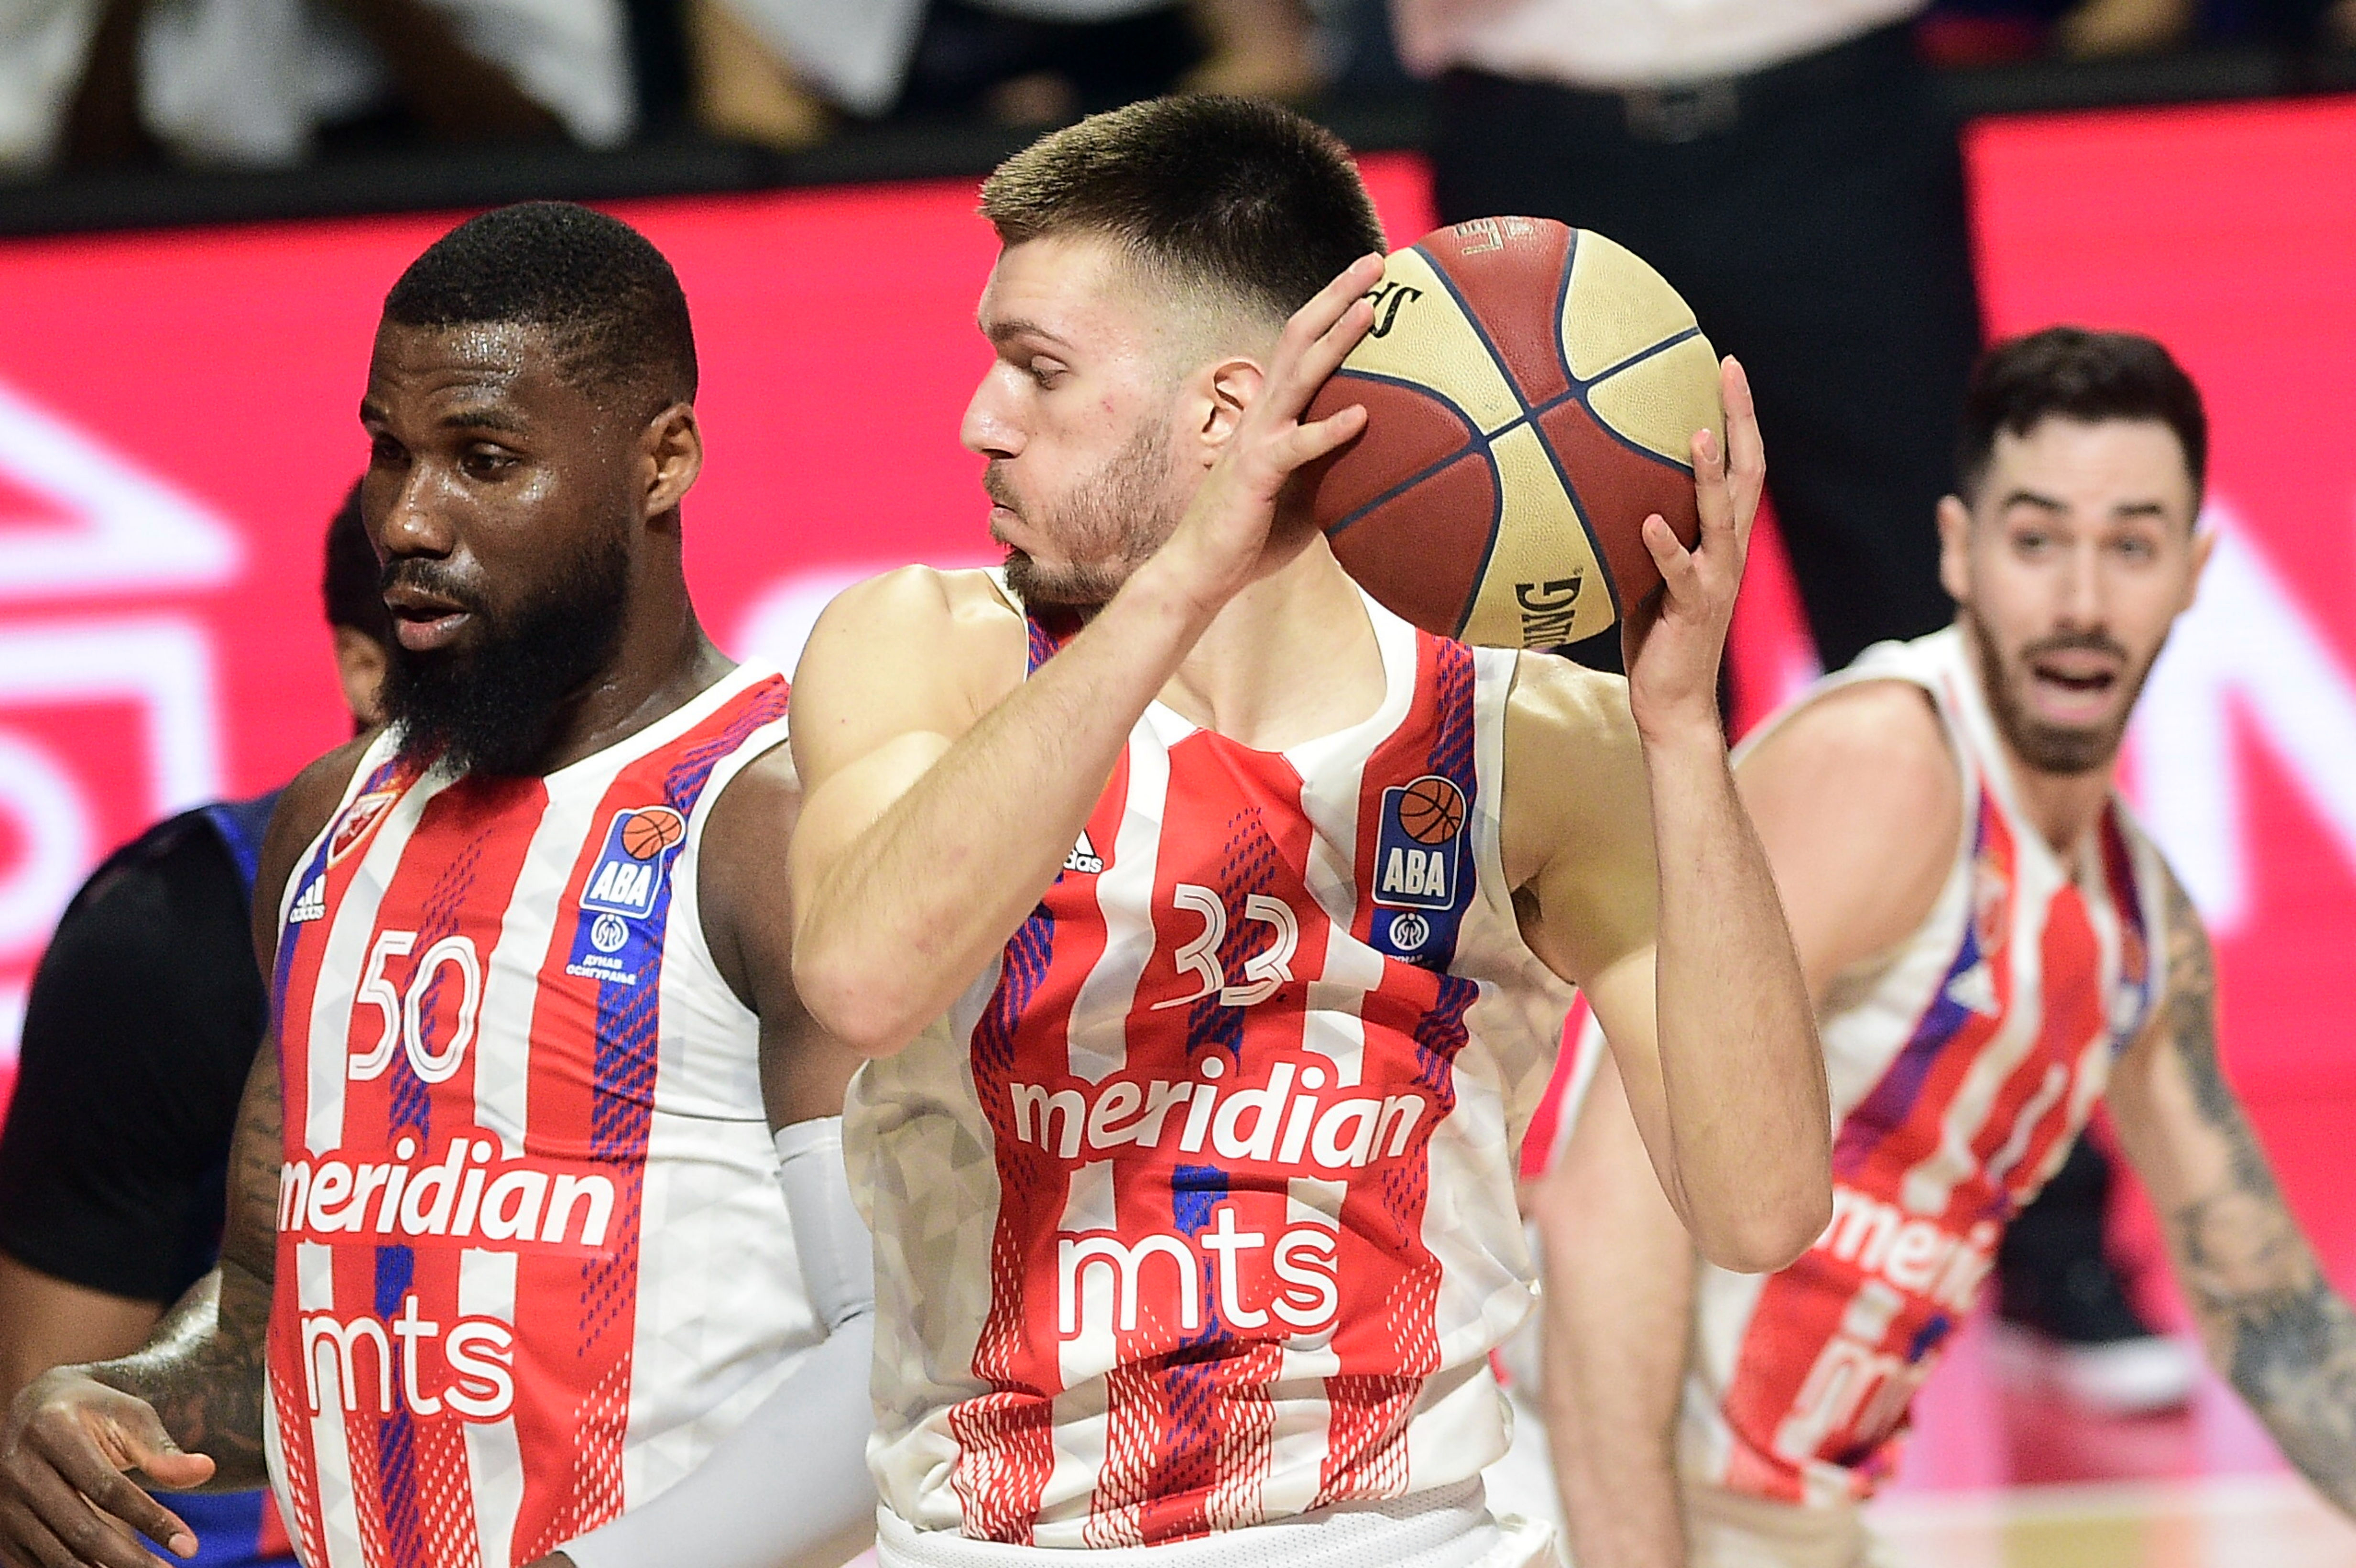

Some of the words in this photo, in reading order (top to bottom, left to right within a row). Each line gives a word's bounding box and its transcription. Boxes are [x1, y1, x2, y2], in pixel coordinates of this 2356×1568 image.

[589, 860, 653, 907] ABA
[1382, 847, 1445, 897] ABA
[1150, 883, 1298, 1010] 33
[348, 930, 481, 1083] 50
[1009, 1057, 1426, 1168] meridian
[276, 1137, 615, 1246] meridian
[1058, 1207, 1338, 1335] mts
[301, 1296, 514, 1417] mts
